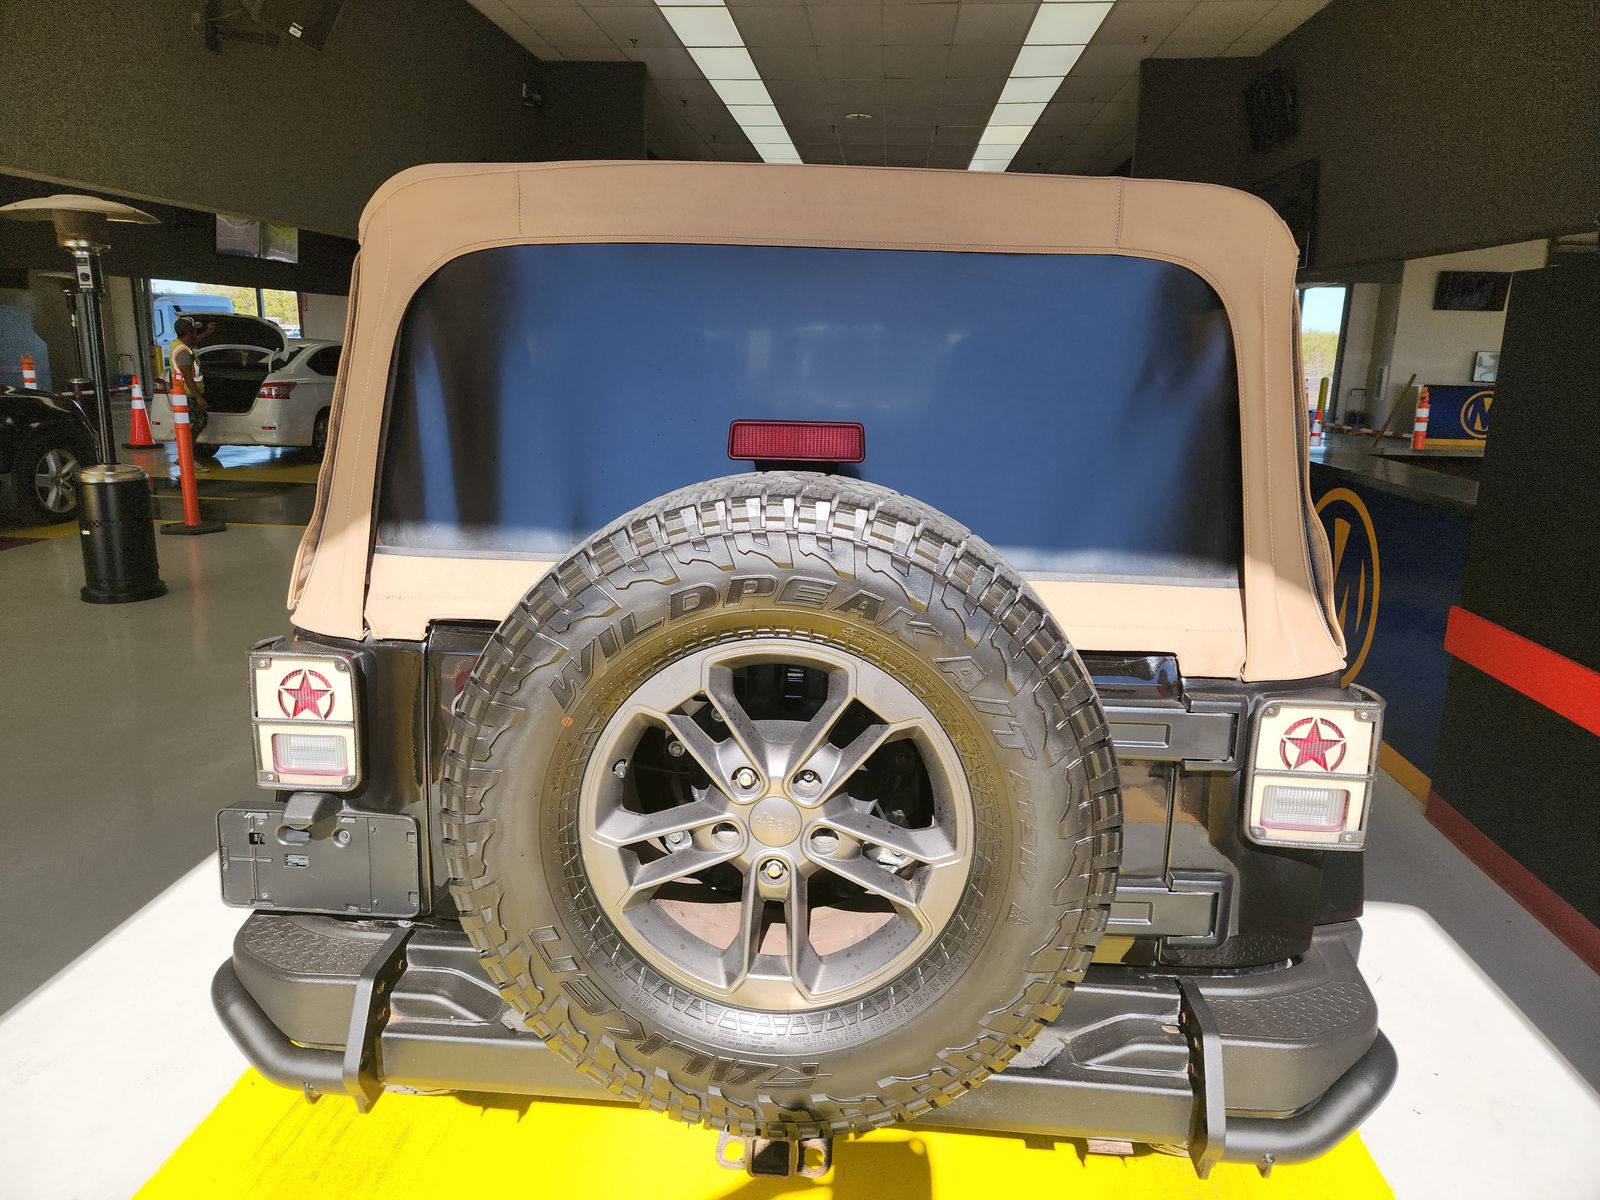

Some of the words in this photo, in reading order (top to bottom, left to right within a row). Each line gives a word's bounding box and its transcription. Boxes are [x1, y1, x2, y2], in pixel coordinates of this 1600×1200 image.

[547, 574, 945, 712] WILDPEAK
[754, 811, 796, 836] Jeep
[528, 924, 834, 1090] FALKEN
